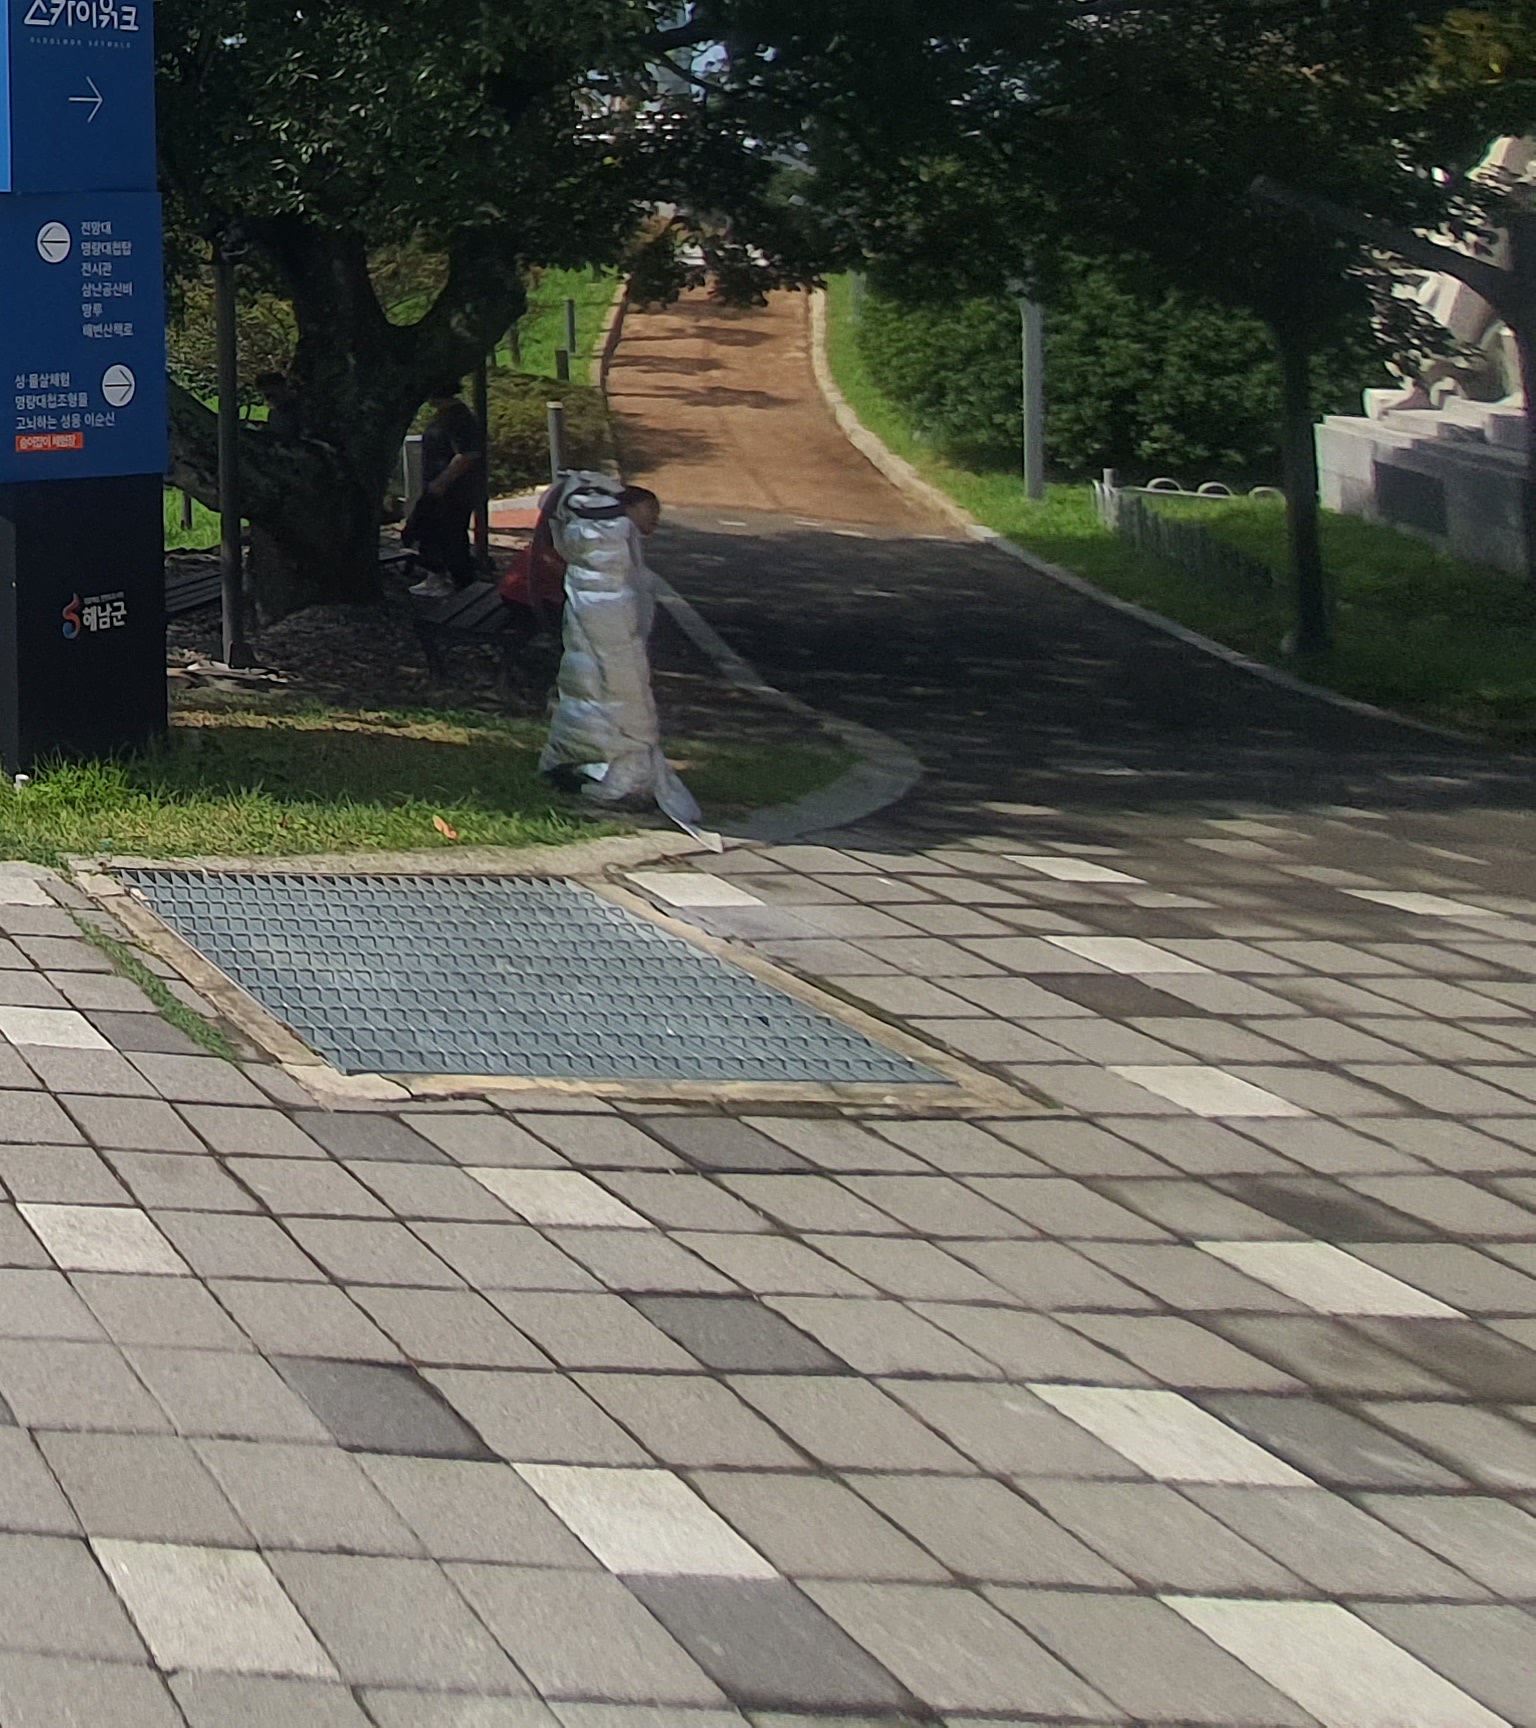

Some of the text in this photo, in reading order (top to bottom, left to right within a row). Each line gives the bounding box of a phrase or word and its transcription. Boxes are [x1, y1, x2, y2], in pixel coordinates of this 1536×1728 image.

[81, 221, 112, 235] 전망대
[81, 262, 112, 276] 전시관
[82, 303, 103, 318] 망루
[82, 322, 133, 338] 해변산책로
[15, 415, 57, 429] 고뇌하는
[84, 411, 115, 427] 이순신
[82, 601, 127, 631] 해남군
